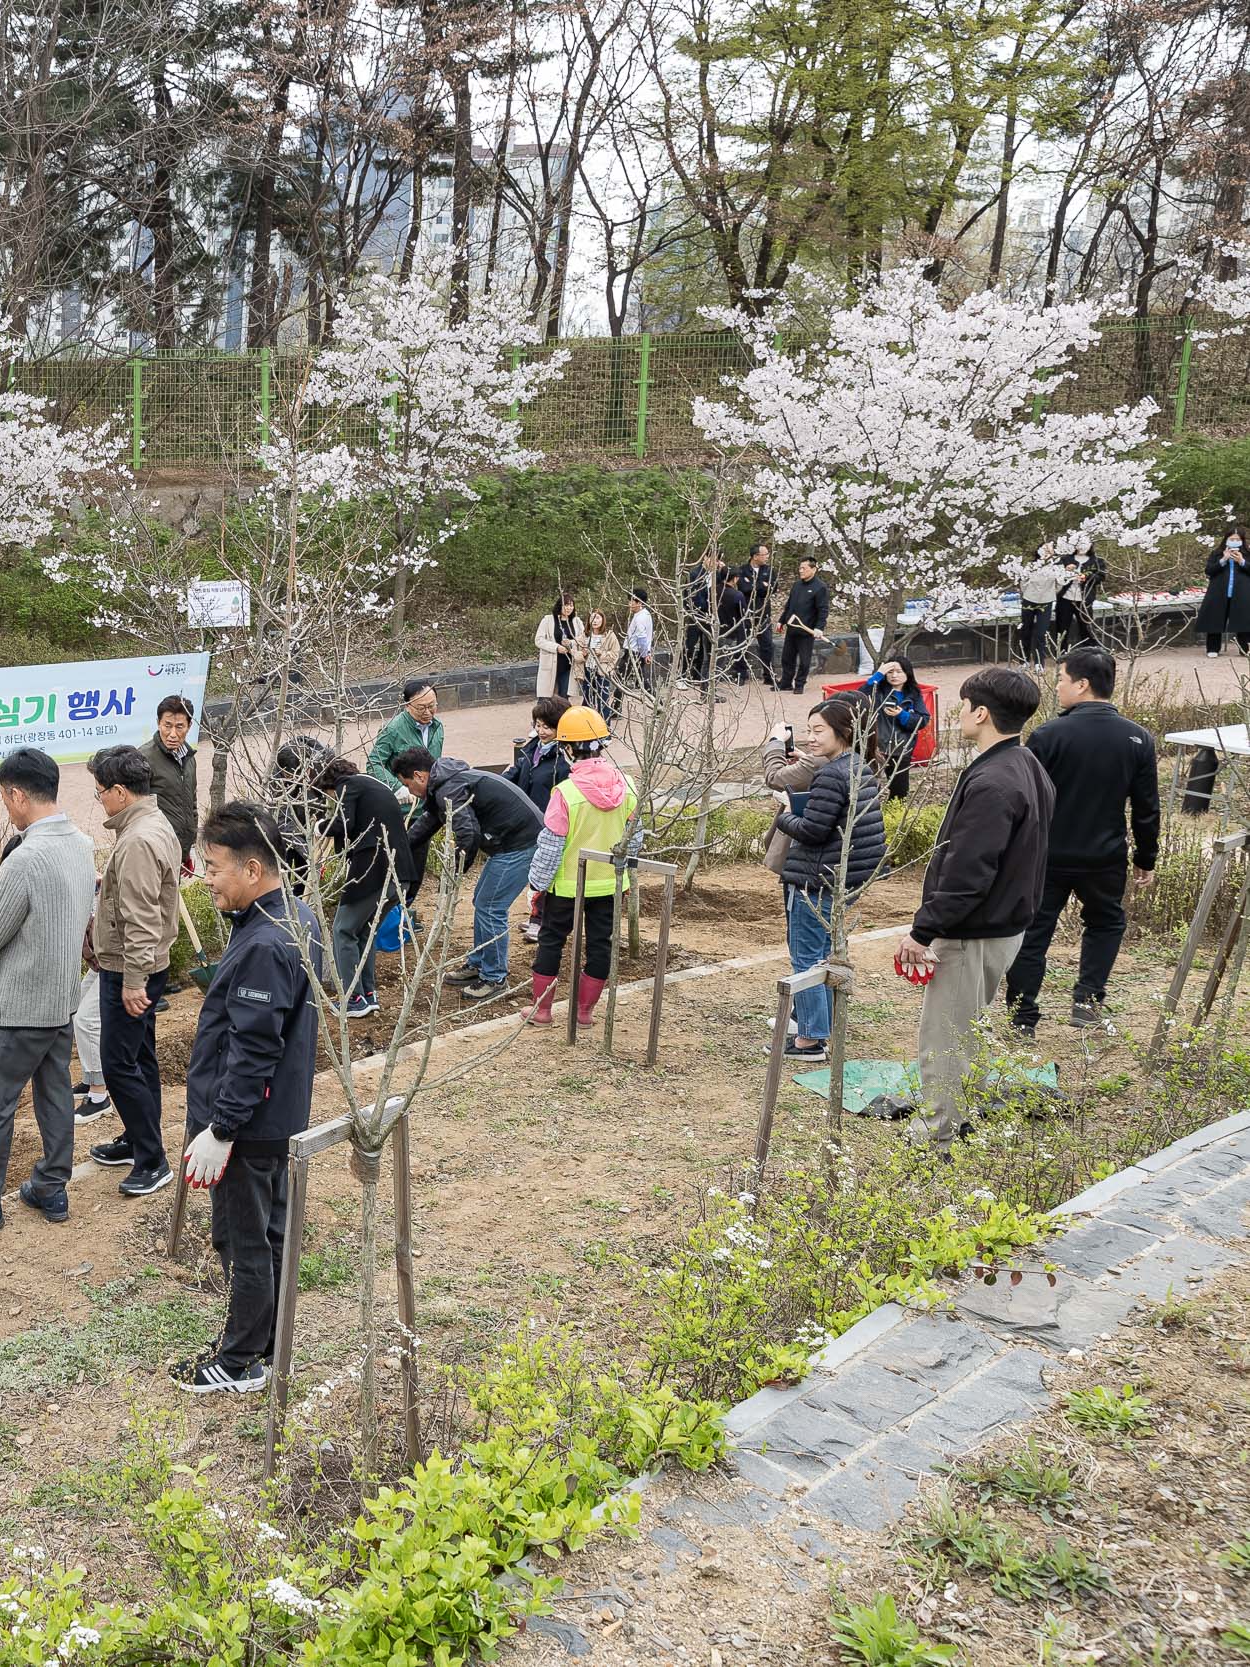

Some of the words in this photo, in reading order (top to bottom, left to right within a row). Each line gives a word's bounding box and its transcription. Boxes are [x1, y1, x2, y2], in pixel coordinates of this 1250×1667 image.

[67, 686, 137, 721] 행사
[58, 727, 93, 739] 401-14
[95, 724, 118, 736] 일대)
